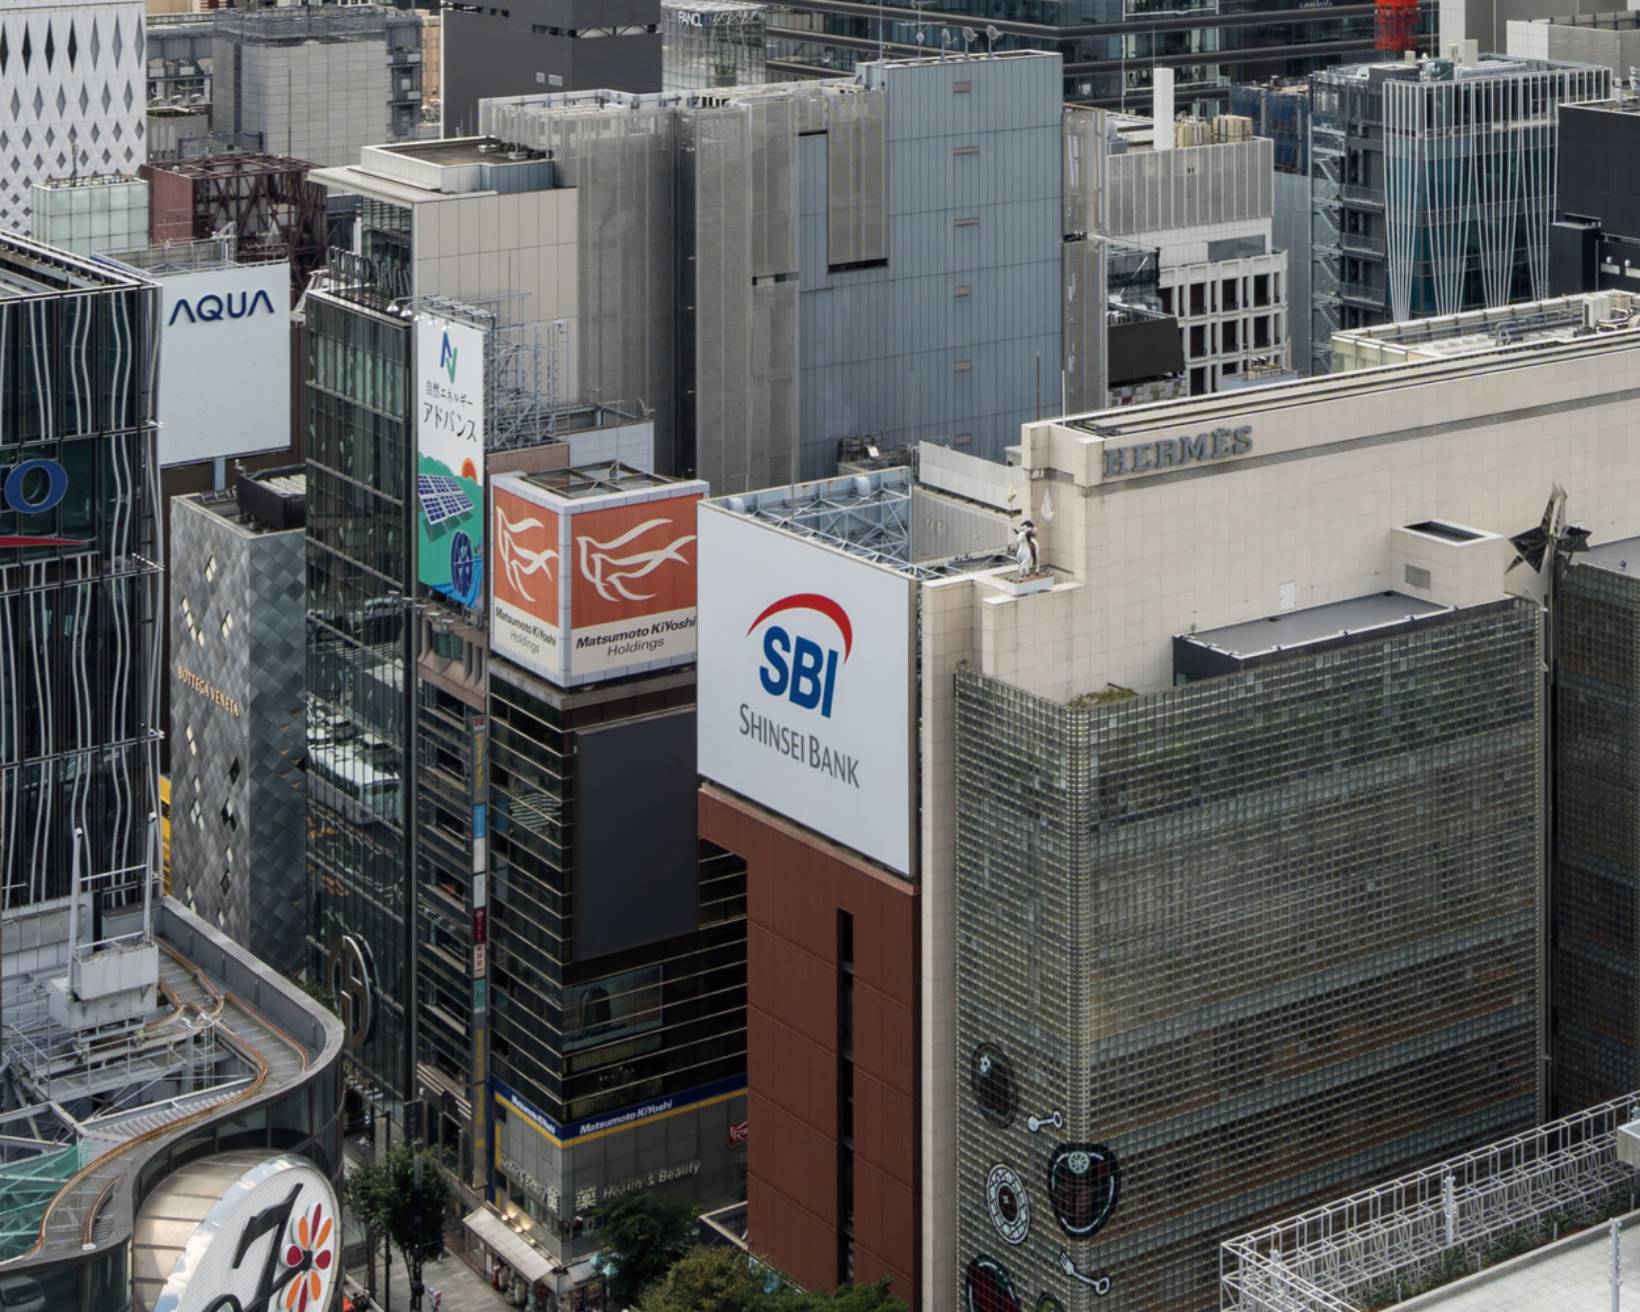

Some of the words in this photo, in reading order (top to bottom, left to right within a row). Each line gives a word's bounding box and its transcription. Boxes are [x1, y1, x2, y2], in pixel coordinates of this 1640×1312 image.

[168, 289, 275, 326] AQUA
[423, 402, 478, 442] アドバンス
[575, 627, 649, 649] Matsumoto
[650, 616, 697, 635] KiYoshi
[607, 637, 665, 657] Holdings
[758, 624, 839, 718] SBI
[580, 1109, 636, 1135] Matsumoto
[658, 1160, 701, 1183] Beauty
